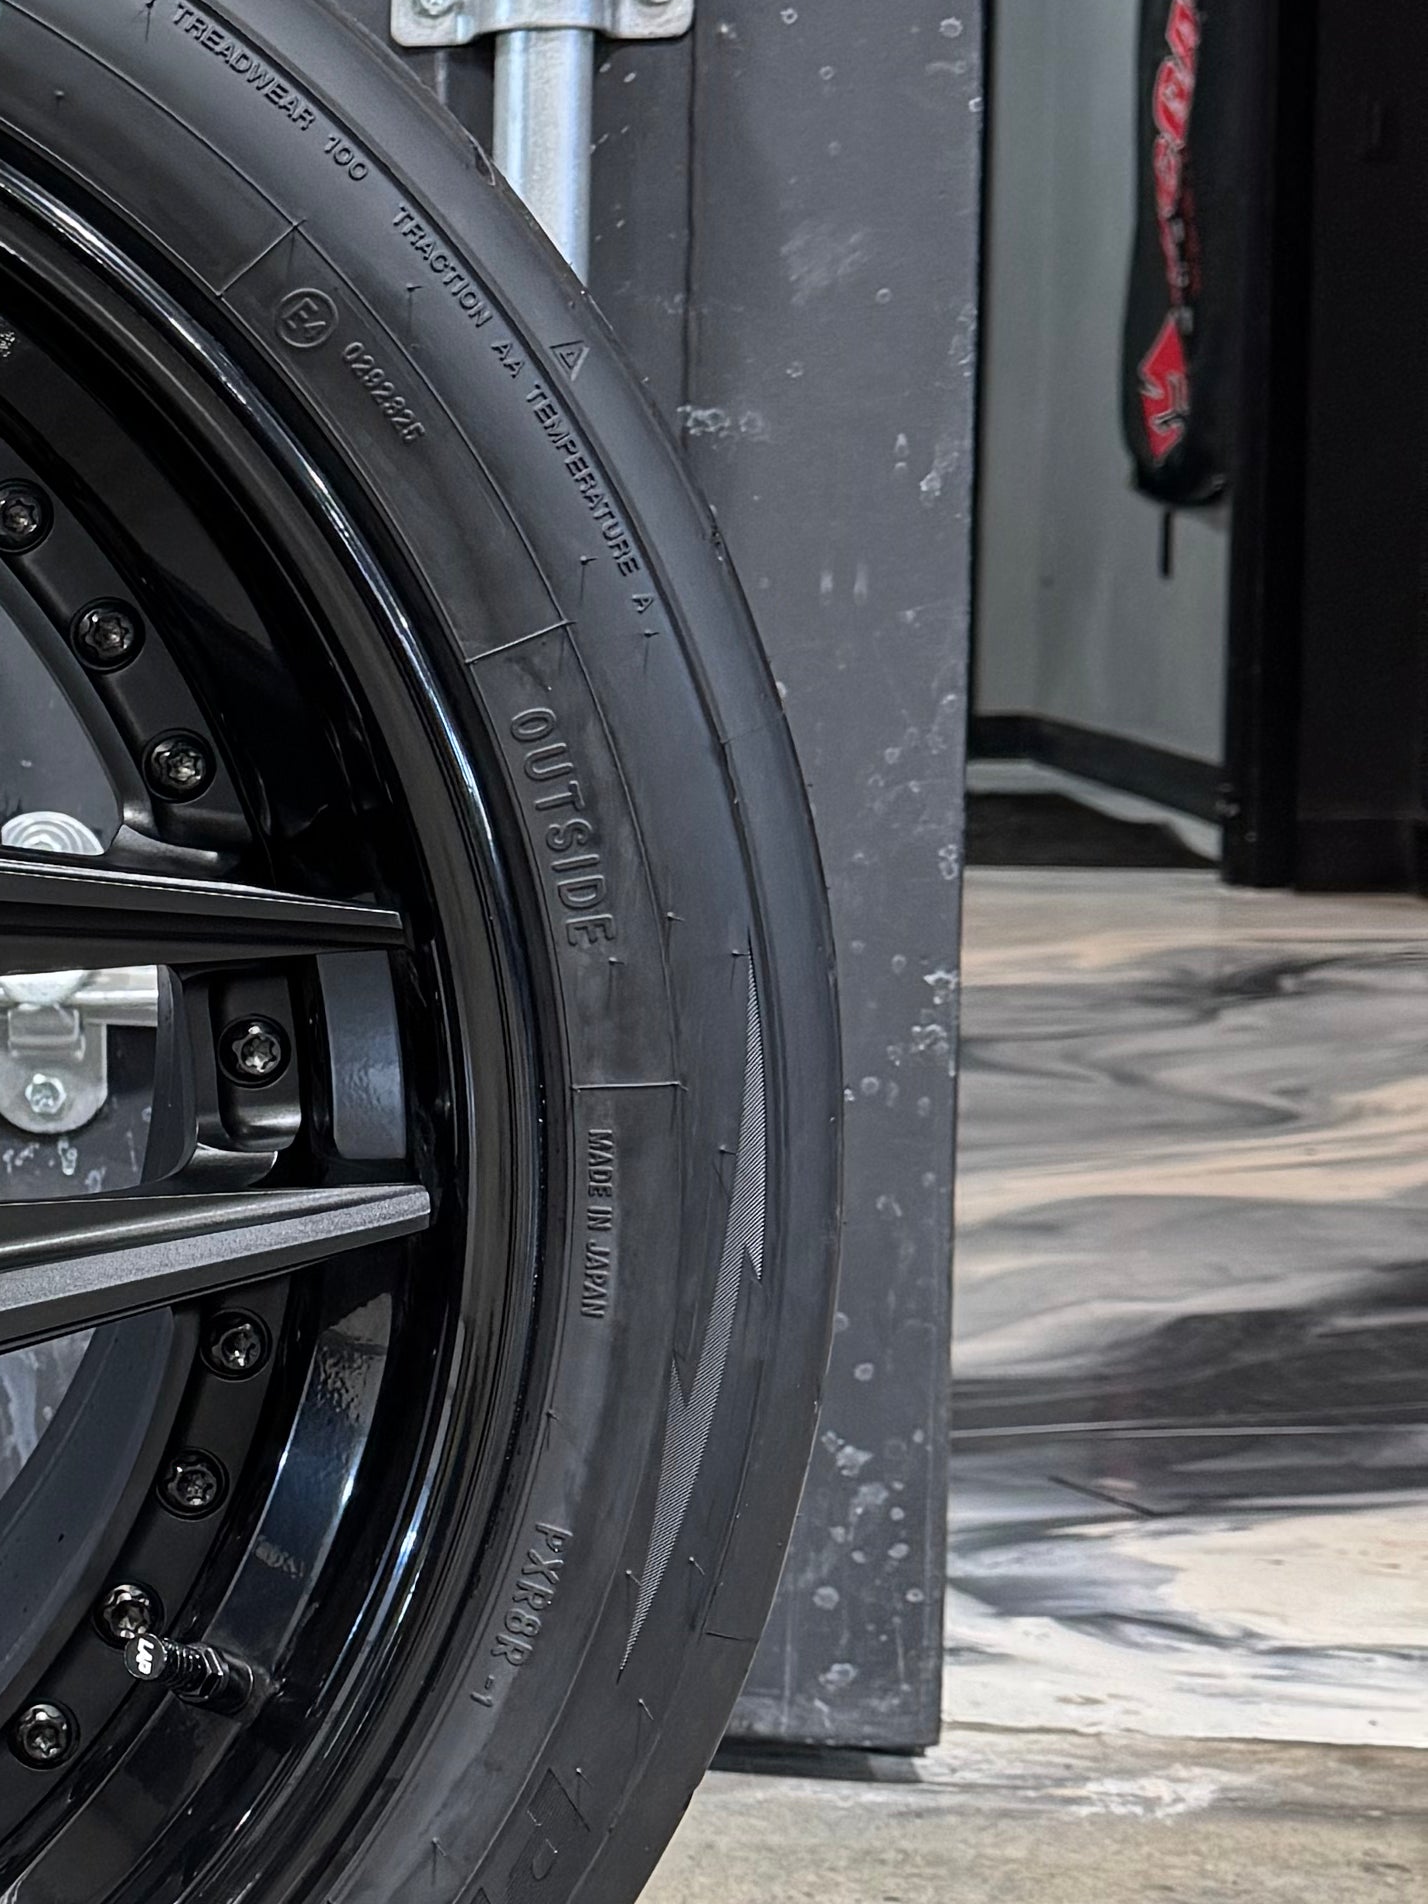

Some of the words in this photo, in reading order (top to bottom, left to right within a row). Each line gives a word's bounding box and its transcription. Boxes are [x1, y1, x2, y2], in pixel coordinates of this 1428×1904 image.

[317, 131, 372, 188] 100
[388, 204, 494, 332] TRACTION
[488, 334, 530, 383] AA
[519, 381, 639, 582] TEMPERATURE
[628, 588, 657, 619] A
[504, 697, 617, 953] OUTSIDE
[585, 1204, 613, 1231] IN
[586, 1126, 614, 1198] MADE
[577, 1238, 612, 1320] JAPAN
[485, 1521, 575, 1670] PXR8R
